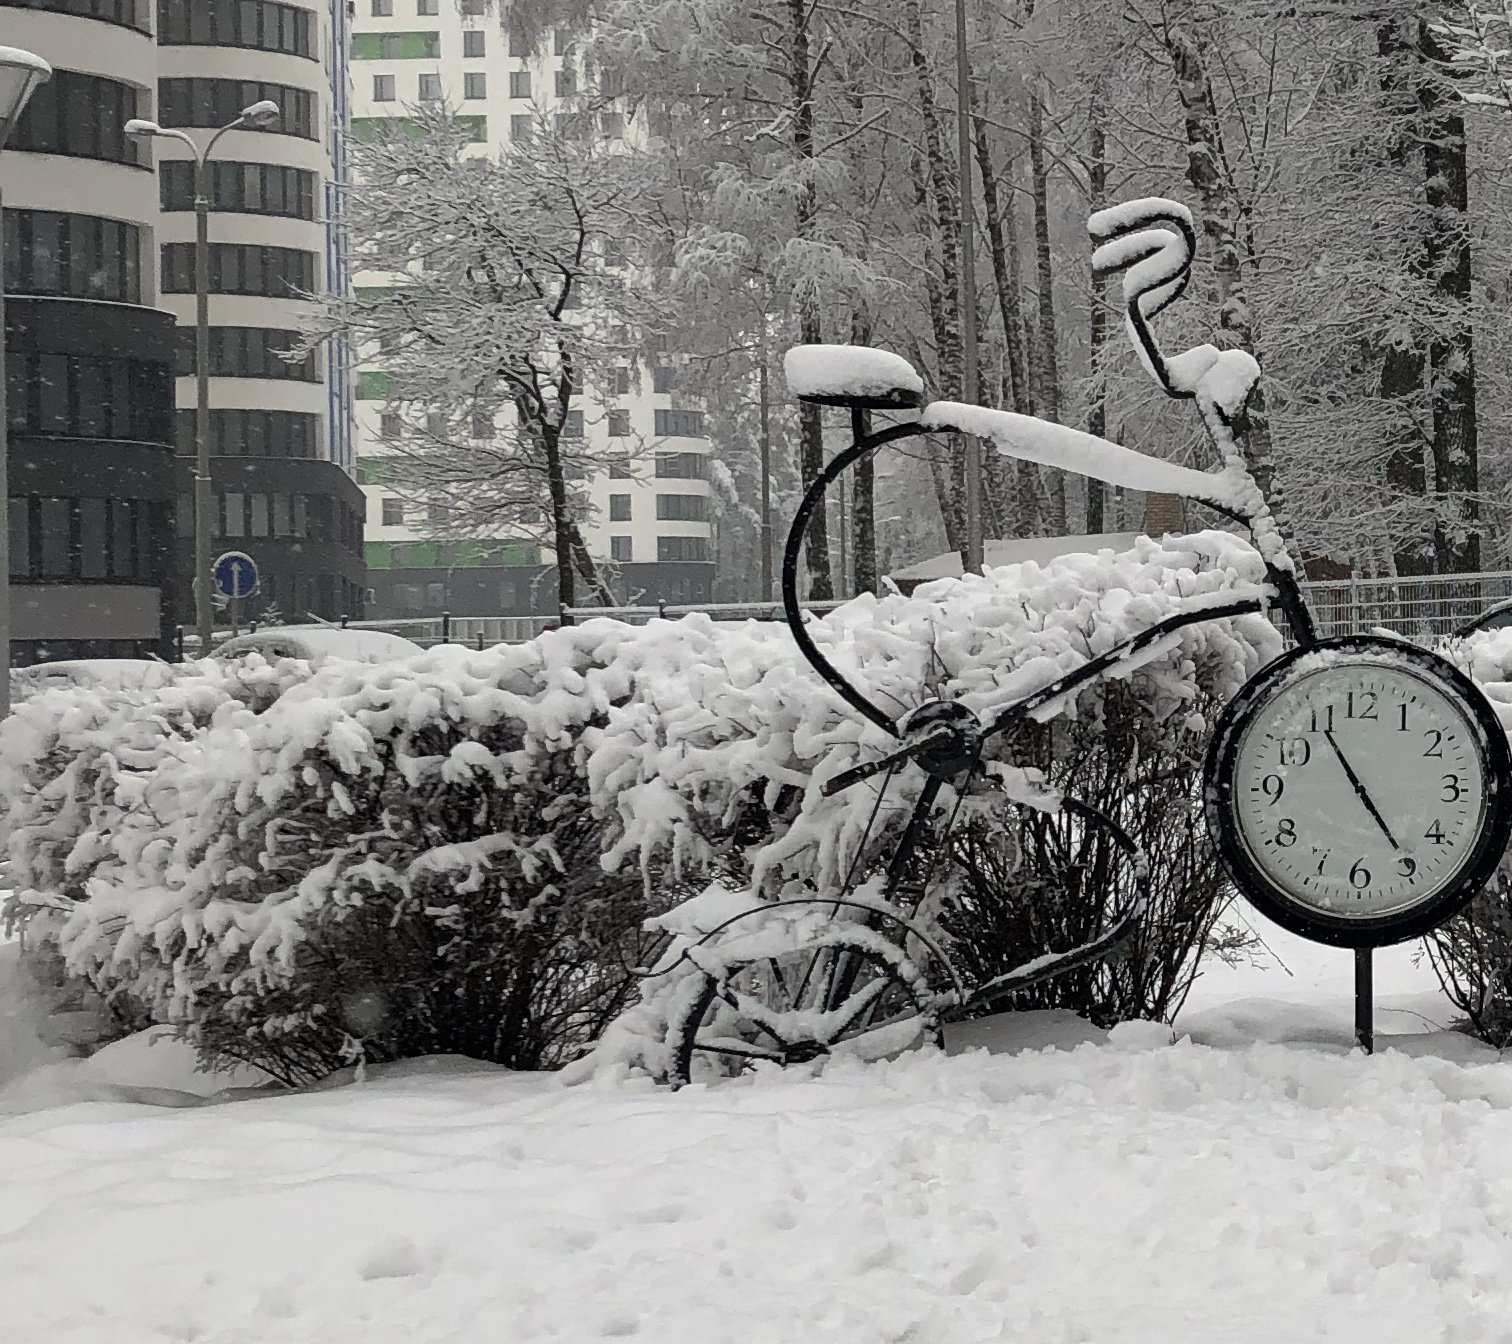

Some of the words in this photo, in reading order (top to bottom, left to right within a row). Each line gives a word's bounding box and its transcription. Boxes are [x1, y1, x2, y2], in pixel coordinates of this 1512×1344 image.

[1307, 705, 1336, 733] 11
[1344, 691, 1378, 721] 12
[1397, 703, 1411, 732] 1
[1278, 737, 1311, 766] 10
[1422, 730, 1443, 758] 2
[1262, 774, 1284, 806] 9
[1440, 774, 1460, 803] 3
[1275, 818, 1297, 847] 8
[1424, 819, 1446, 845] 4
[1312, 847, 1331, 876] 7
[1349, 857, 1371, 889] 6
